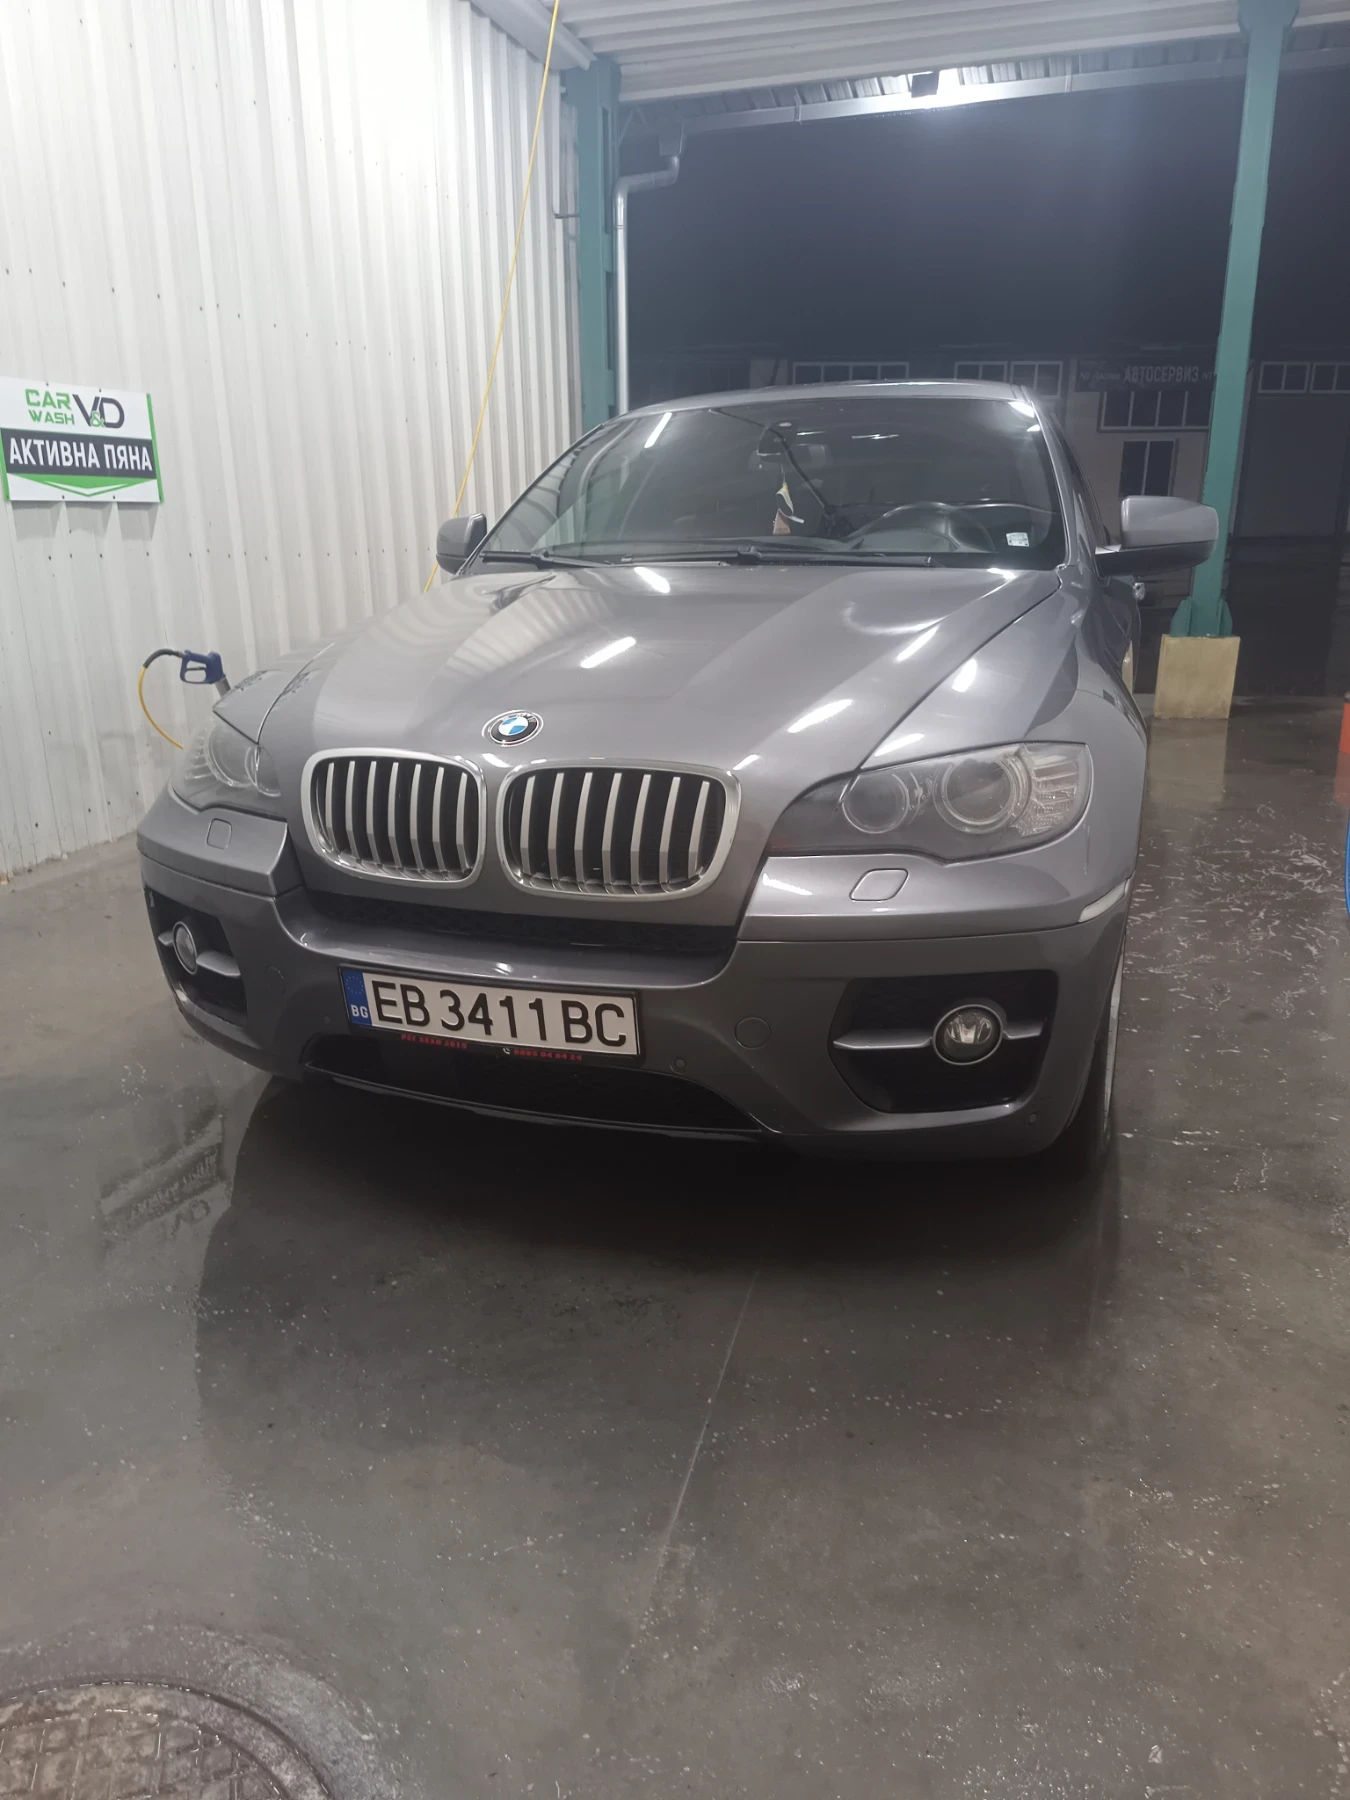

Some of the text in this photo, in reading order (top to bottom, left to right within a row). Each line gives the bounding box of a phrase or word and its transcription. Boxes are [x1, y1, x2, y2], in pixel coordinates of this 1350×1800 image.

[1123, 365, 1199, 384] АВТОСЕРВИЗ
[25, 388, 72, 410] CAR
[28, 409, 75, 425] WASH
[10, 437, 153, 471] АКТИВНА ПЯНА
[351, 1004, 369, 1019] BG
[439, 989, 547, 1041] 3411
